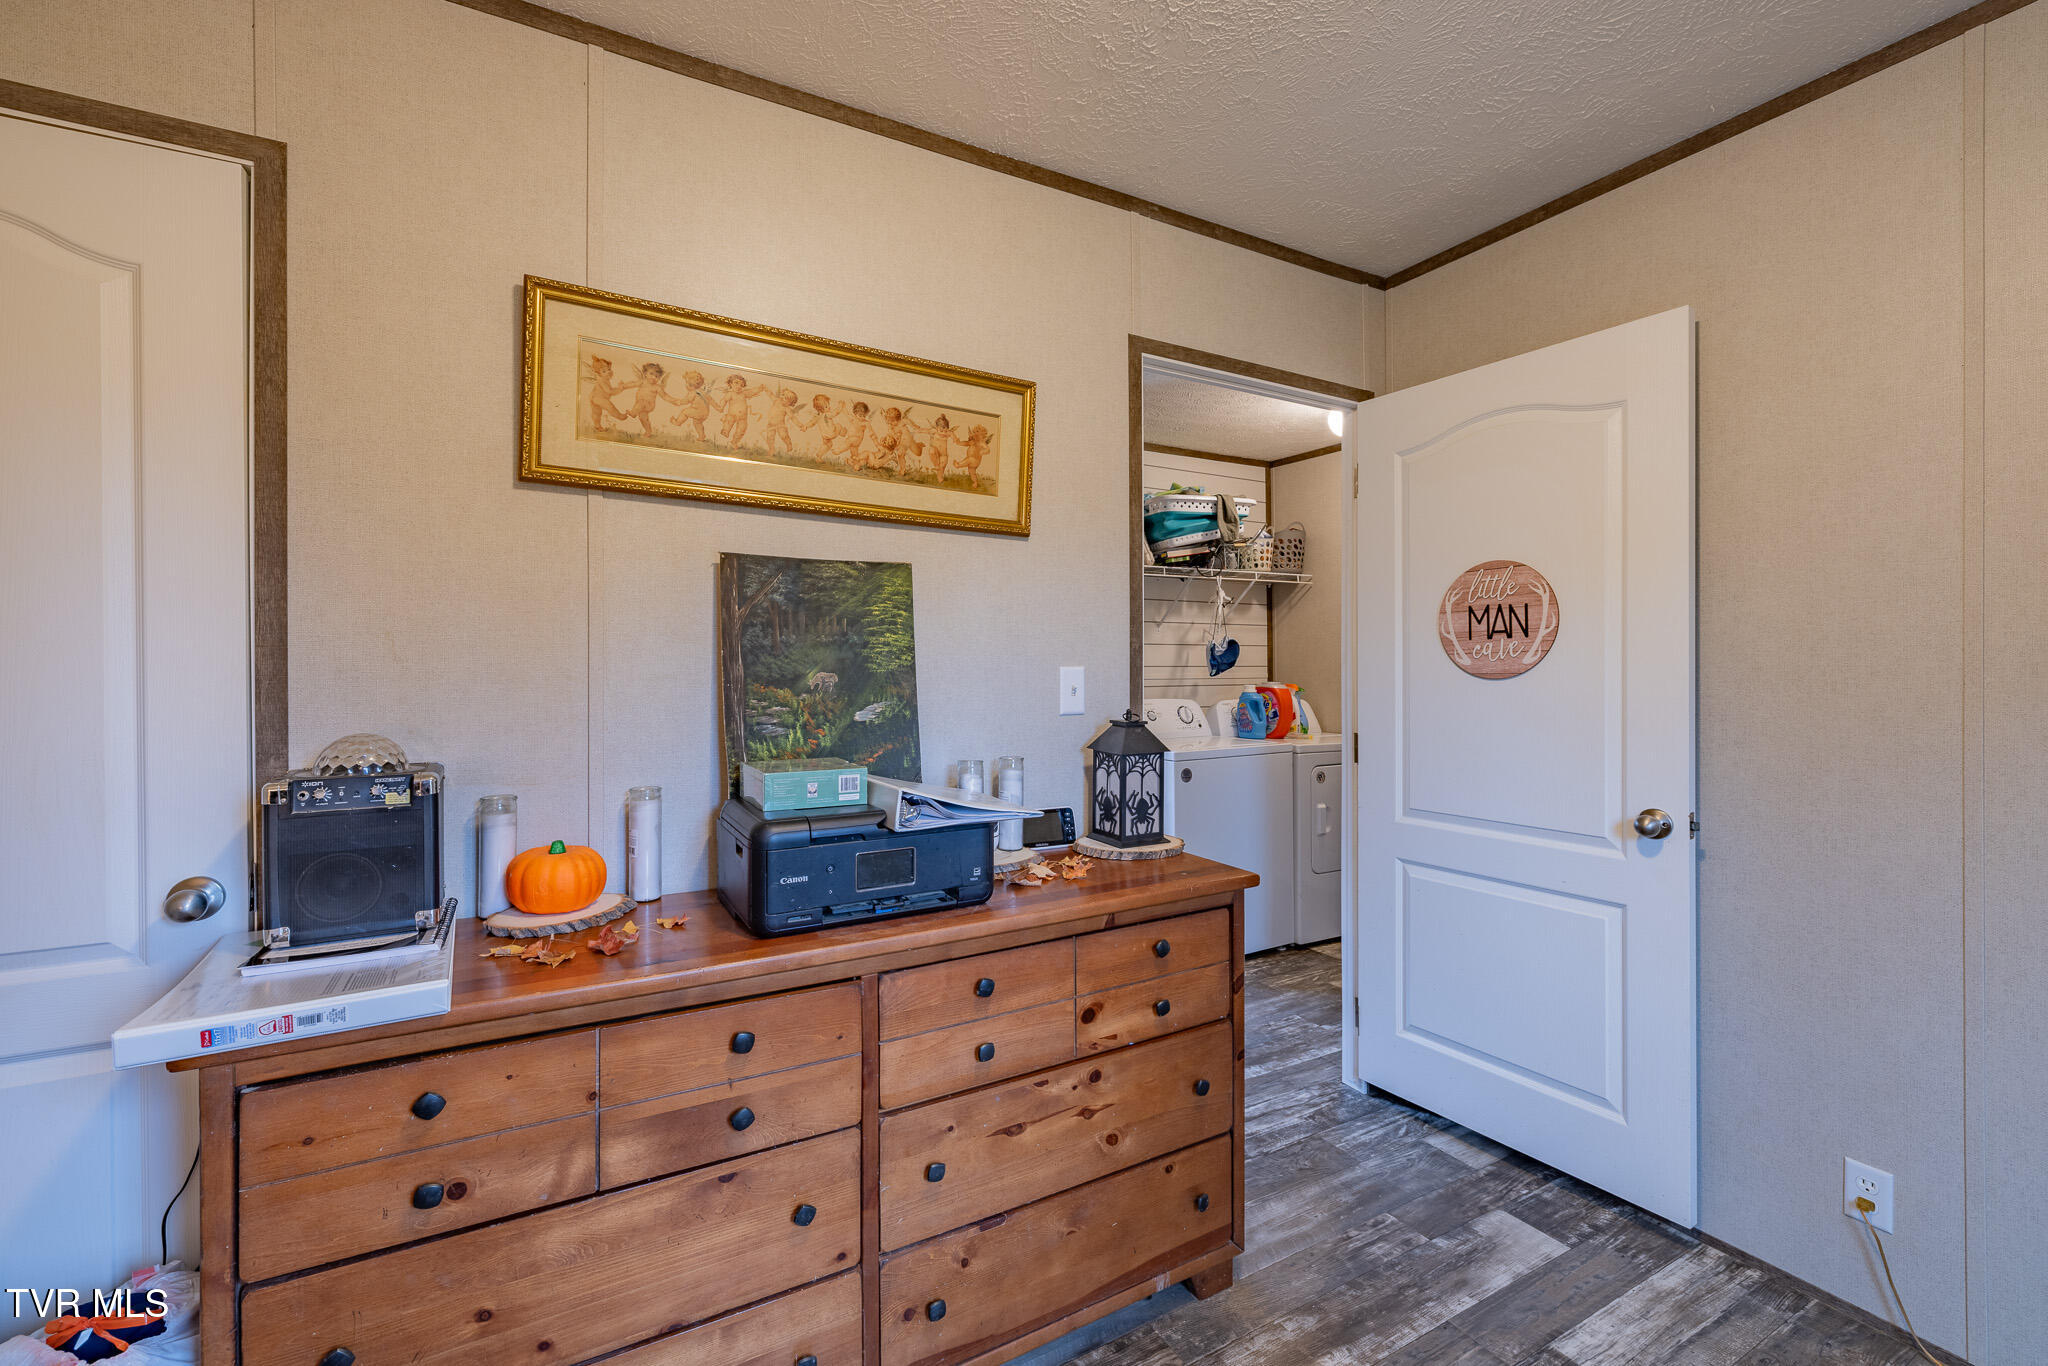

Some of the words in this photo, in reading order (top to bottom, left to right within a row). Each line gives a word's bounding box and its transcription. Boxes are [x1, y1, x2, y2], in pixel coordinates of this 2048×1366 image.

[1468, 565, 1520, 603] little
[1468, 603, 1529, 641] MAN
[1472, 638, 1525, 662] cave
[779, 875, 809, 885] Canon
